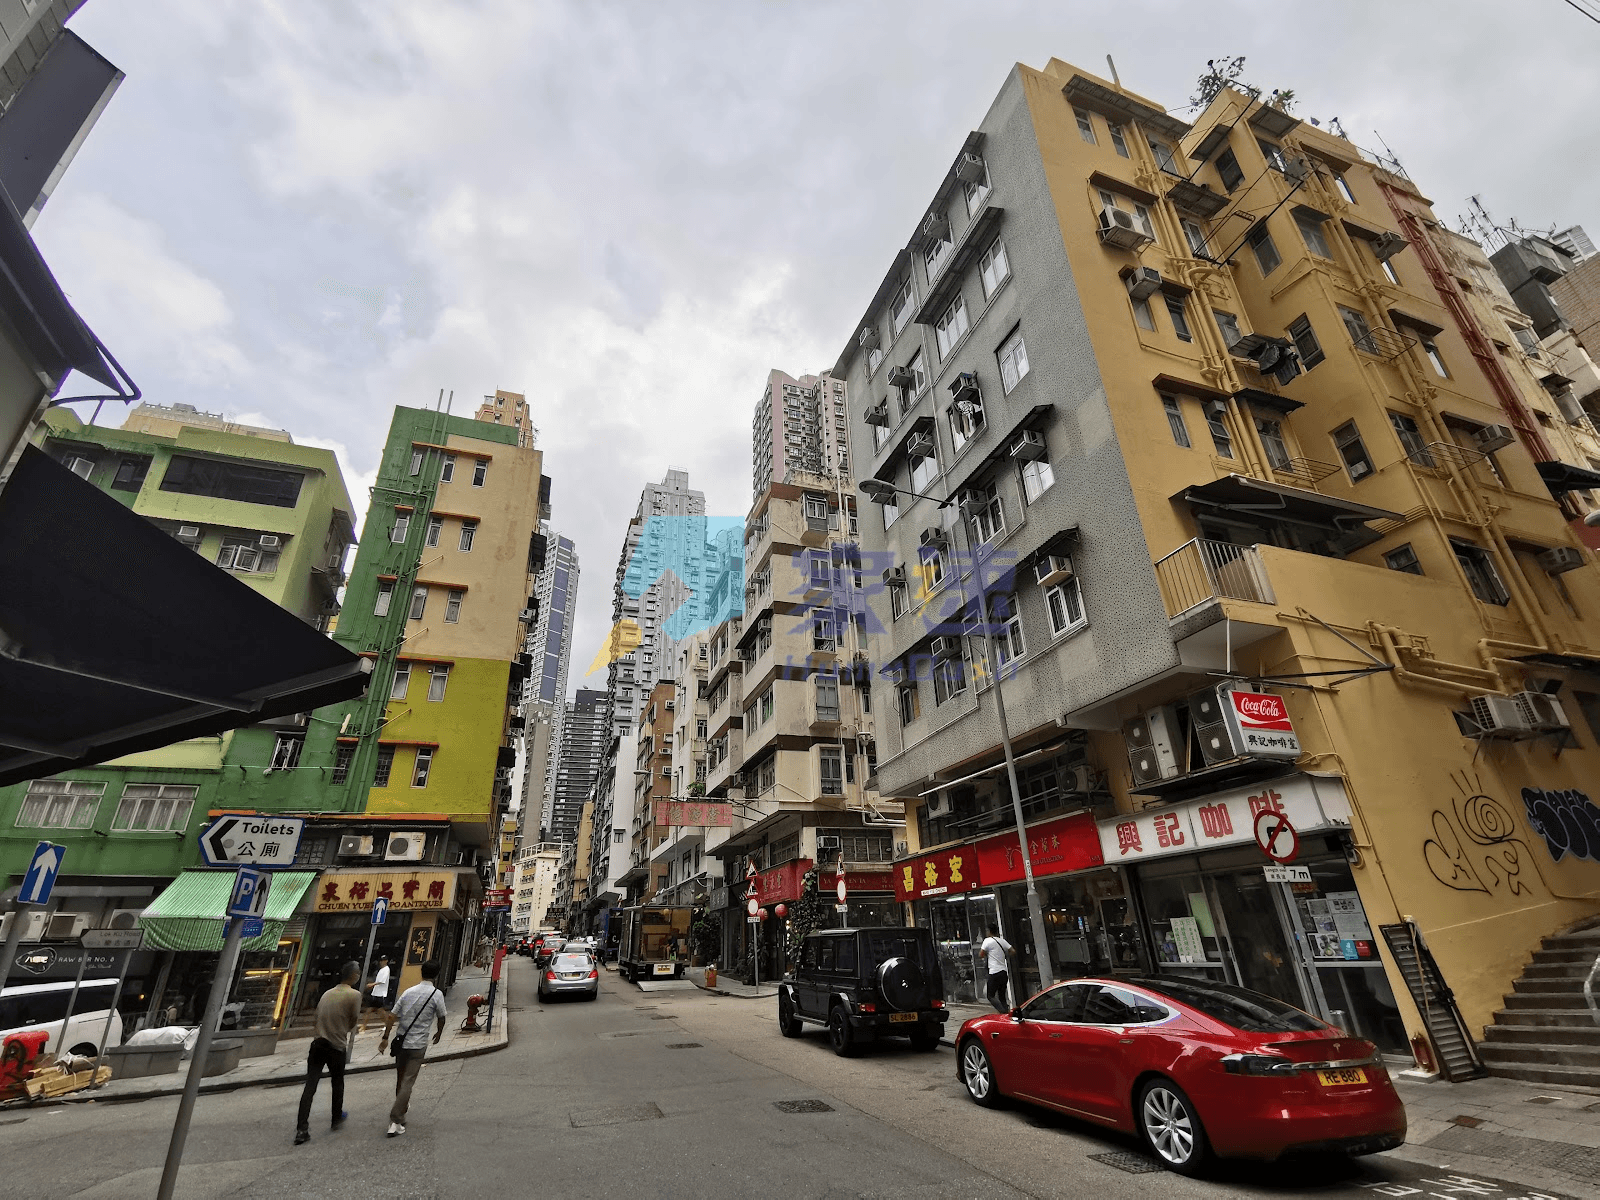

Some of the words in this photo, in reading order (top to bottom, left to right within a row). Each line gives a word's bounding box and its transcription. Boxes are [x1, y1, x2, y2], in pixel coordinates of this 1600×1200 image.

[242, 822, 295, 836] Toilets
[235, 877, 254, 905] P
[318, 902, 350, 910] CHUEN
[401, 900, 444, 908] ANTIQUES
[1324, 1070, 1341, 1084] RE
[1340, 1069, 1361, 1083] 880
